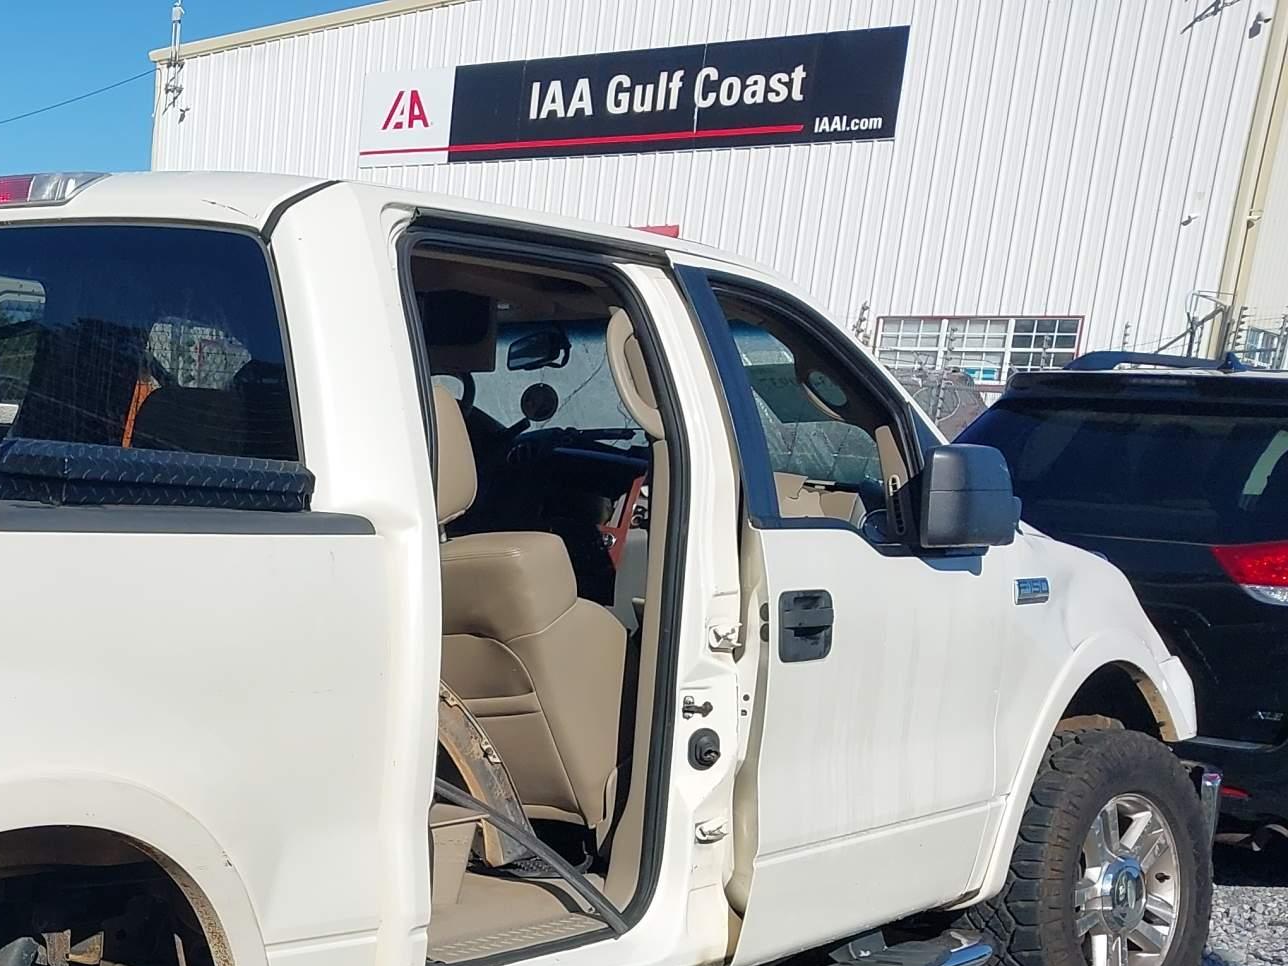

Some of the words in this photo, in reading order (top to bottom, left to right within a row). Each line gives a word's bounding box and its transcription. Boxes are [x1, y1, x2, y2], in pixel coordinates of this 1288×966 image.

[529, 78, 593, 120] IAA
[606, 69, 685, 115] Gulf
[694, 64, 807, 109] Coast
[813, 115, 883, 133] IAAI.com
